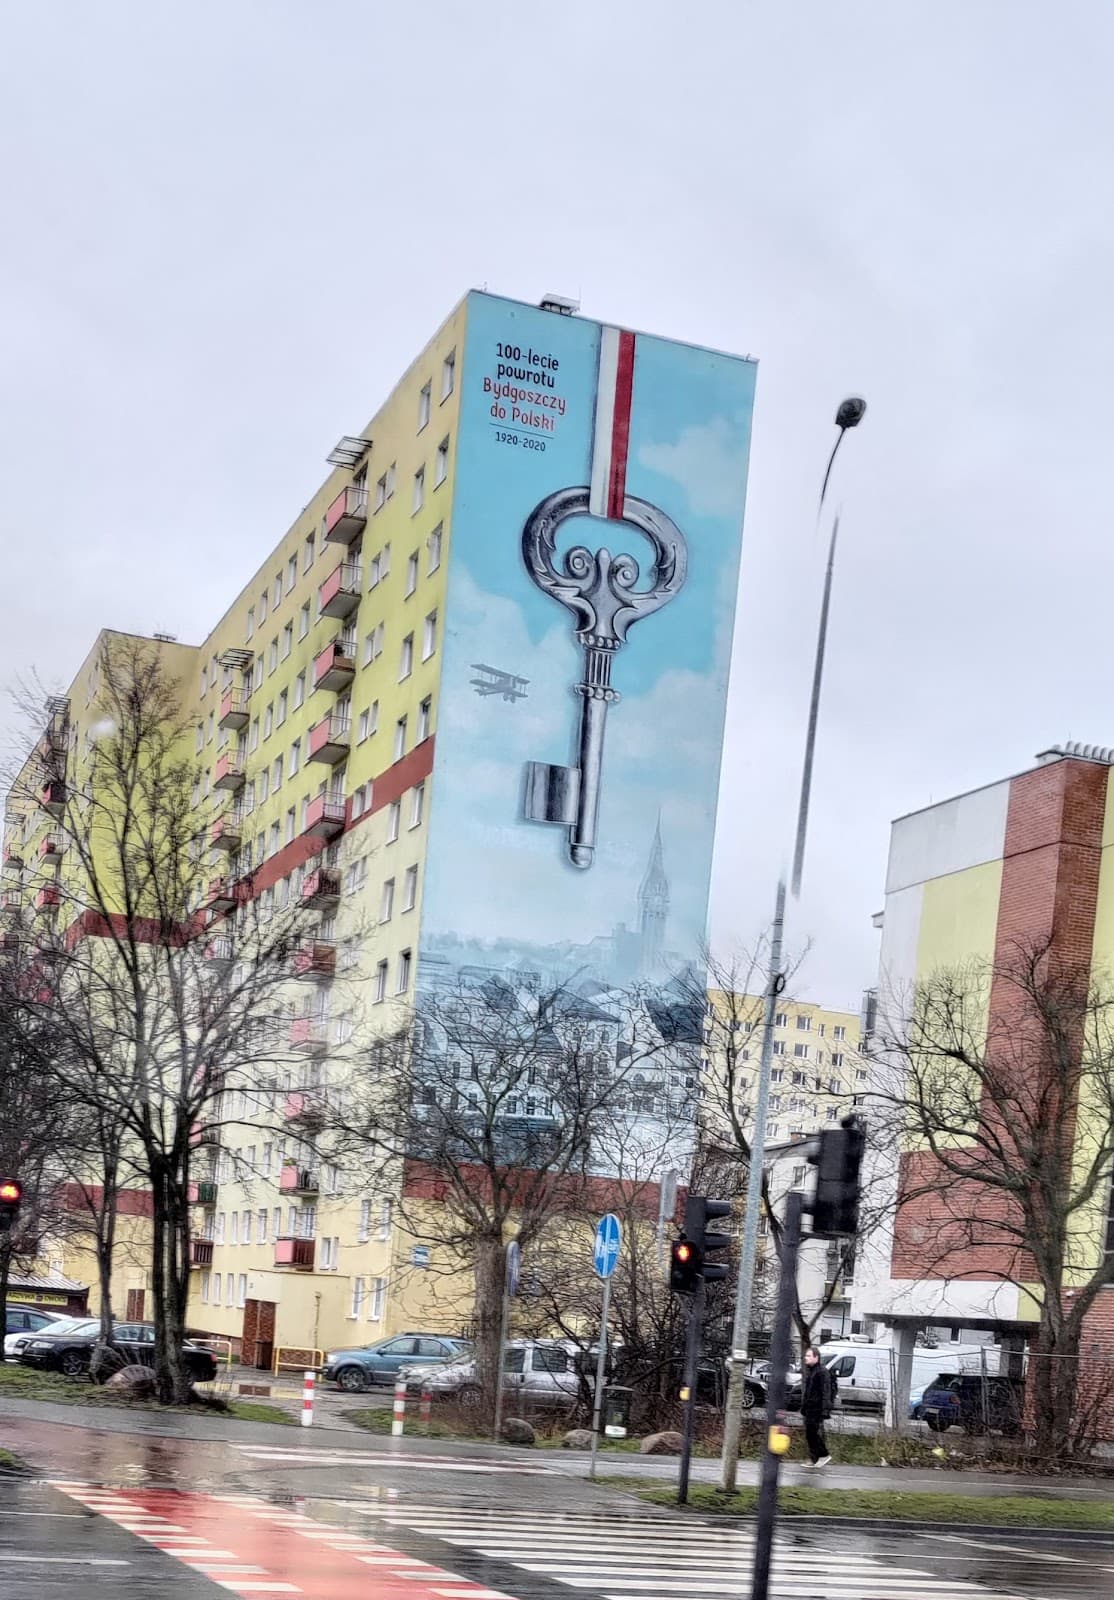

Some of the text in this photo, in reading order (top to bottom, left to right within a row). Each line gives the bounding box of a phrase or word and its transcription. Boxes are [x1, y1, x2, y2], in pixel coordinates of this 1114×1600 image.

[496, 342, 559, 370] 100-lecie
[497, 363, 555, 388] powrotu
[483, 377, 566, 415] Bydgoszczy
[490, 402, 555, 431] do Polski
[495, 431, 546, 452] 1920-2020
